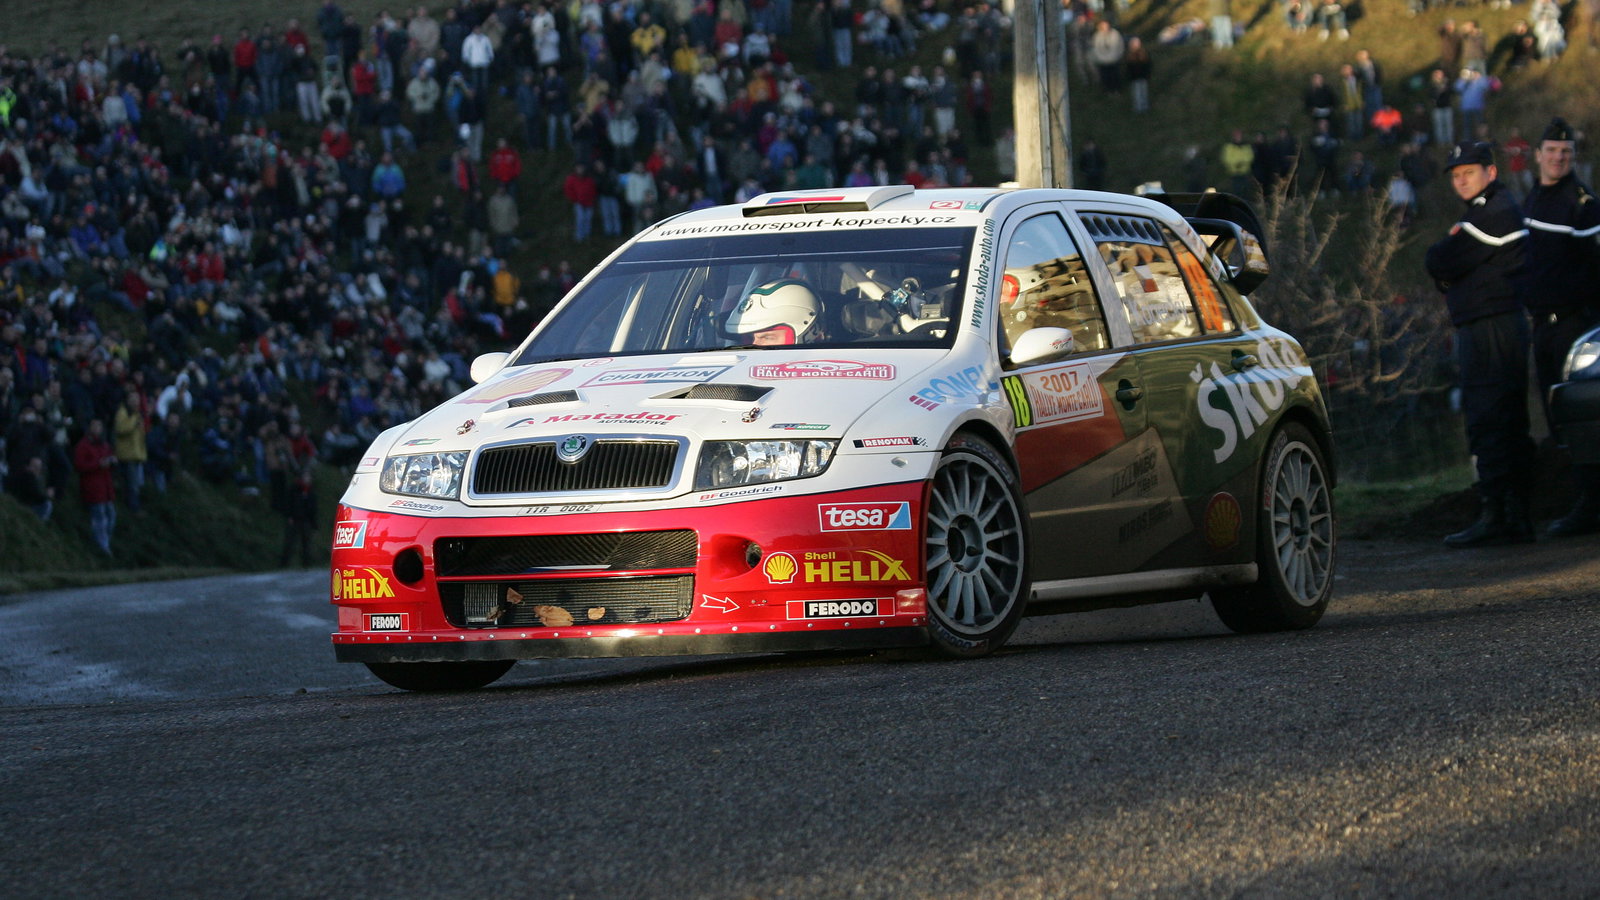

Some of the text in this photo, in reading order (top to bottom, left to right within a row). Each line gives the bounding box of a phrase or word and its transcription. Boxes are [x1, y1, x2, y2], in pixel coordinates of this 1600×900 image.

[660, 214, 957, 237] www.motorsport-kopecky.cz
[971, 218, 996, 329] www.skoda-auto.com
[599, 369, 715, 383] CHAMPION
[757, 368, 797, 377] RALLYE
[1040, 371, 1079, 393] 2007
[1004, 374, 1031, 427] 18
[1029, 384, 1057, 418] RALLYE
[542, 411, 683, 424] Matador
[864, 437, 911, 447] RENOVAK
[700, 485, 783, 501] BFGoodrich
[391, 499, 444, 512] BFGoodrich
[560, 504, 594, 512] 0002
[825, 507, 884, 527] tesa
[335, 525, 355, 545] tesa
[804, 552, 836, 560] Shell
[343, 569, 355, 577] Shell
[804, 550, 912, 583] HELIX
[343, 568, 395, 599] HELIX
[809, 601, 874, 616] FERODO
[372, 616, 401, 629] FERODO
